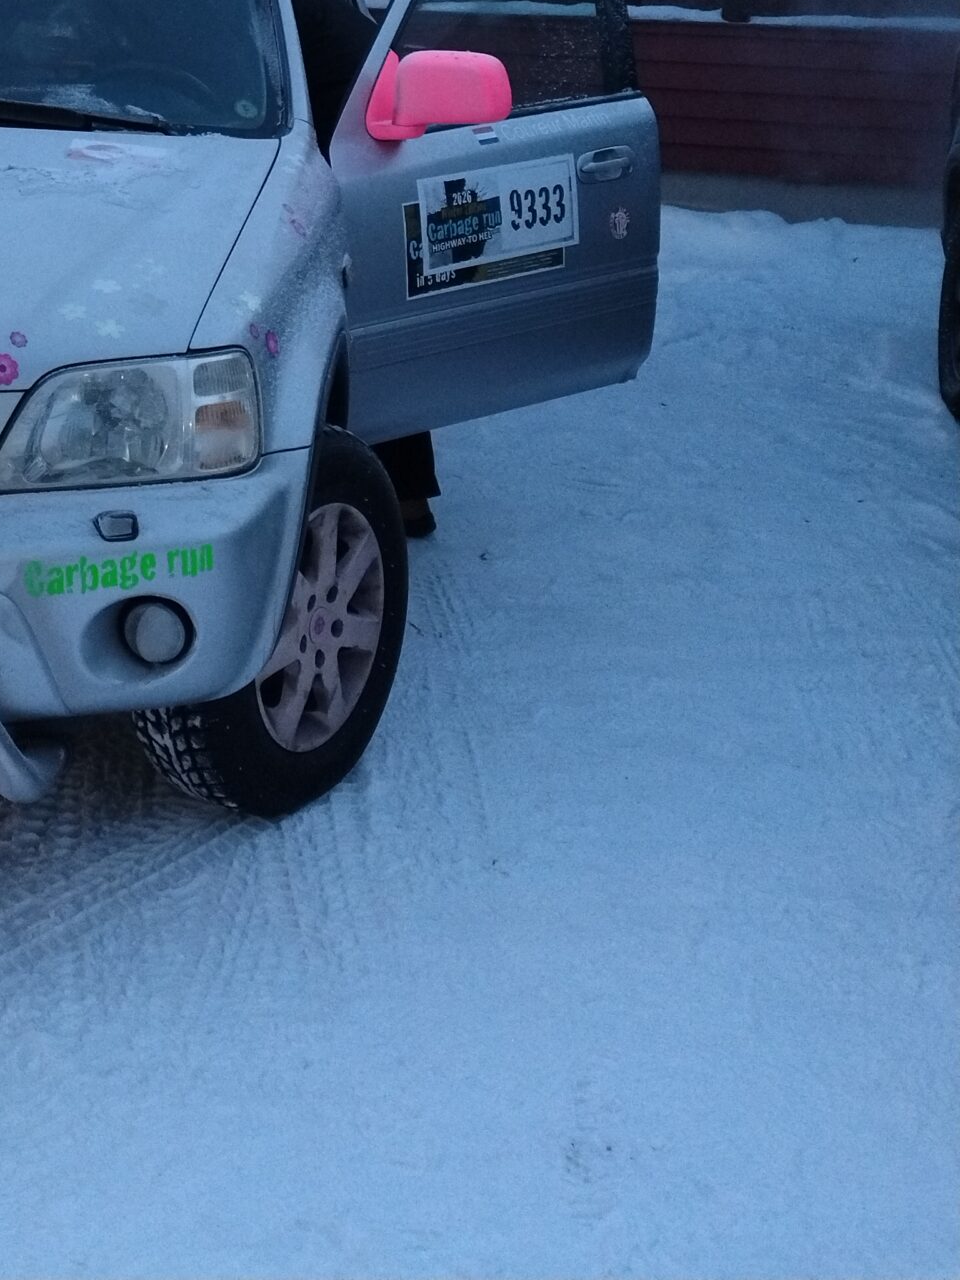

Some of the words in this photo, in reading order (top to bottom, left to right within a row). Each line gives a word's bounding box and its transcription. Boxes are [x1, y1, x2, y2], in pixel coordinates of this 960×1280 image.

[452, 190, 472, 206] 2026
[509, 183, 566, 232] 9333
[427, 216, 479, 242] Carbage
[482, 210, 502, 228] run
[432, 236, 466, 253] HIGHWAY
[167, 543, 213, 576] run
